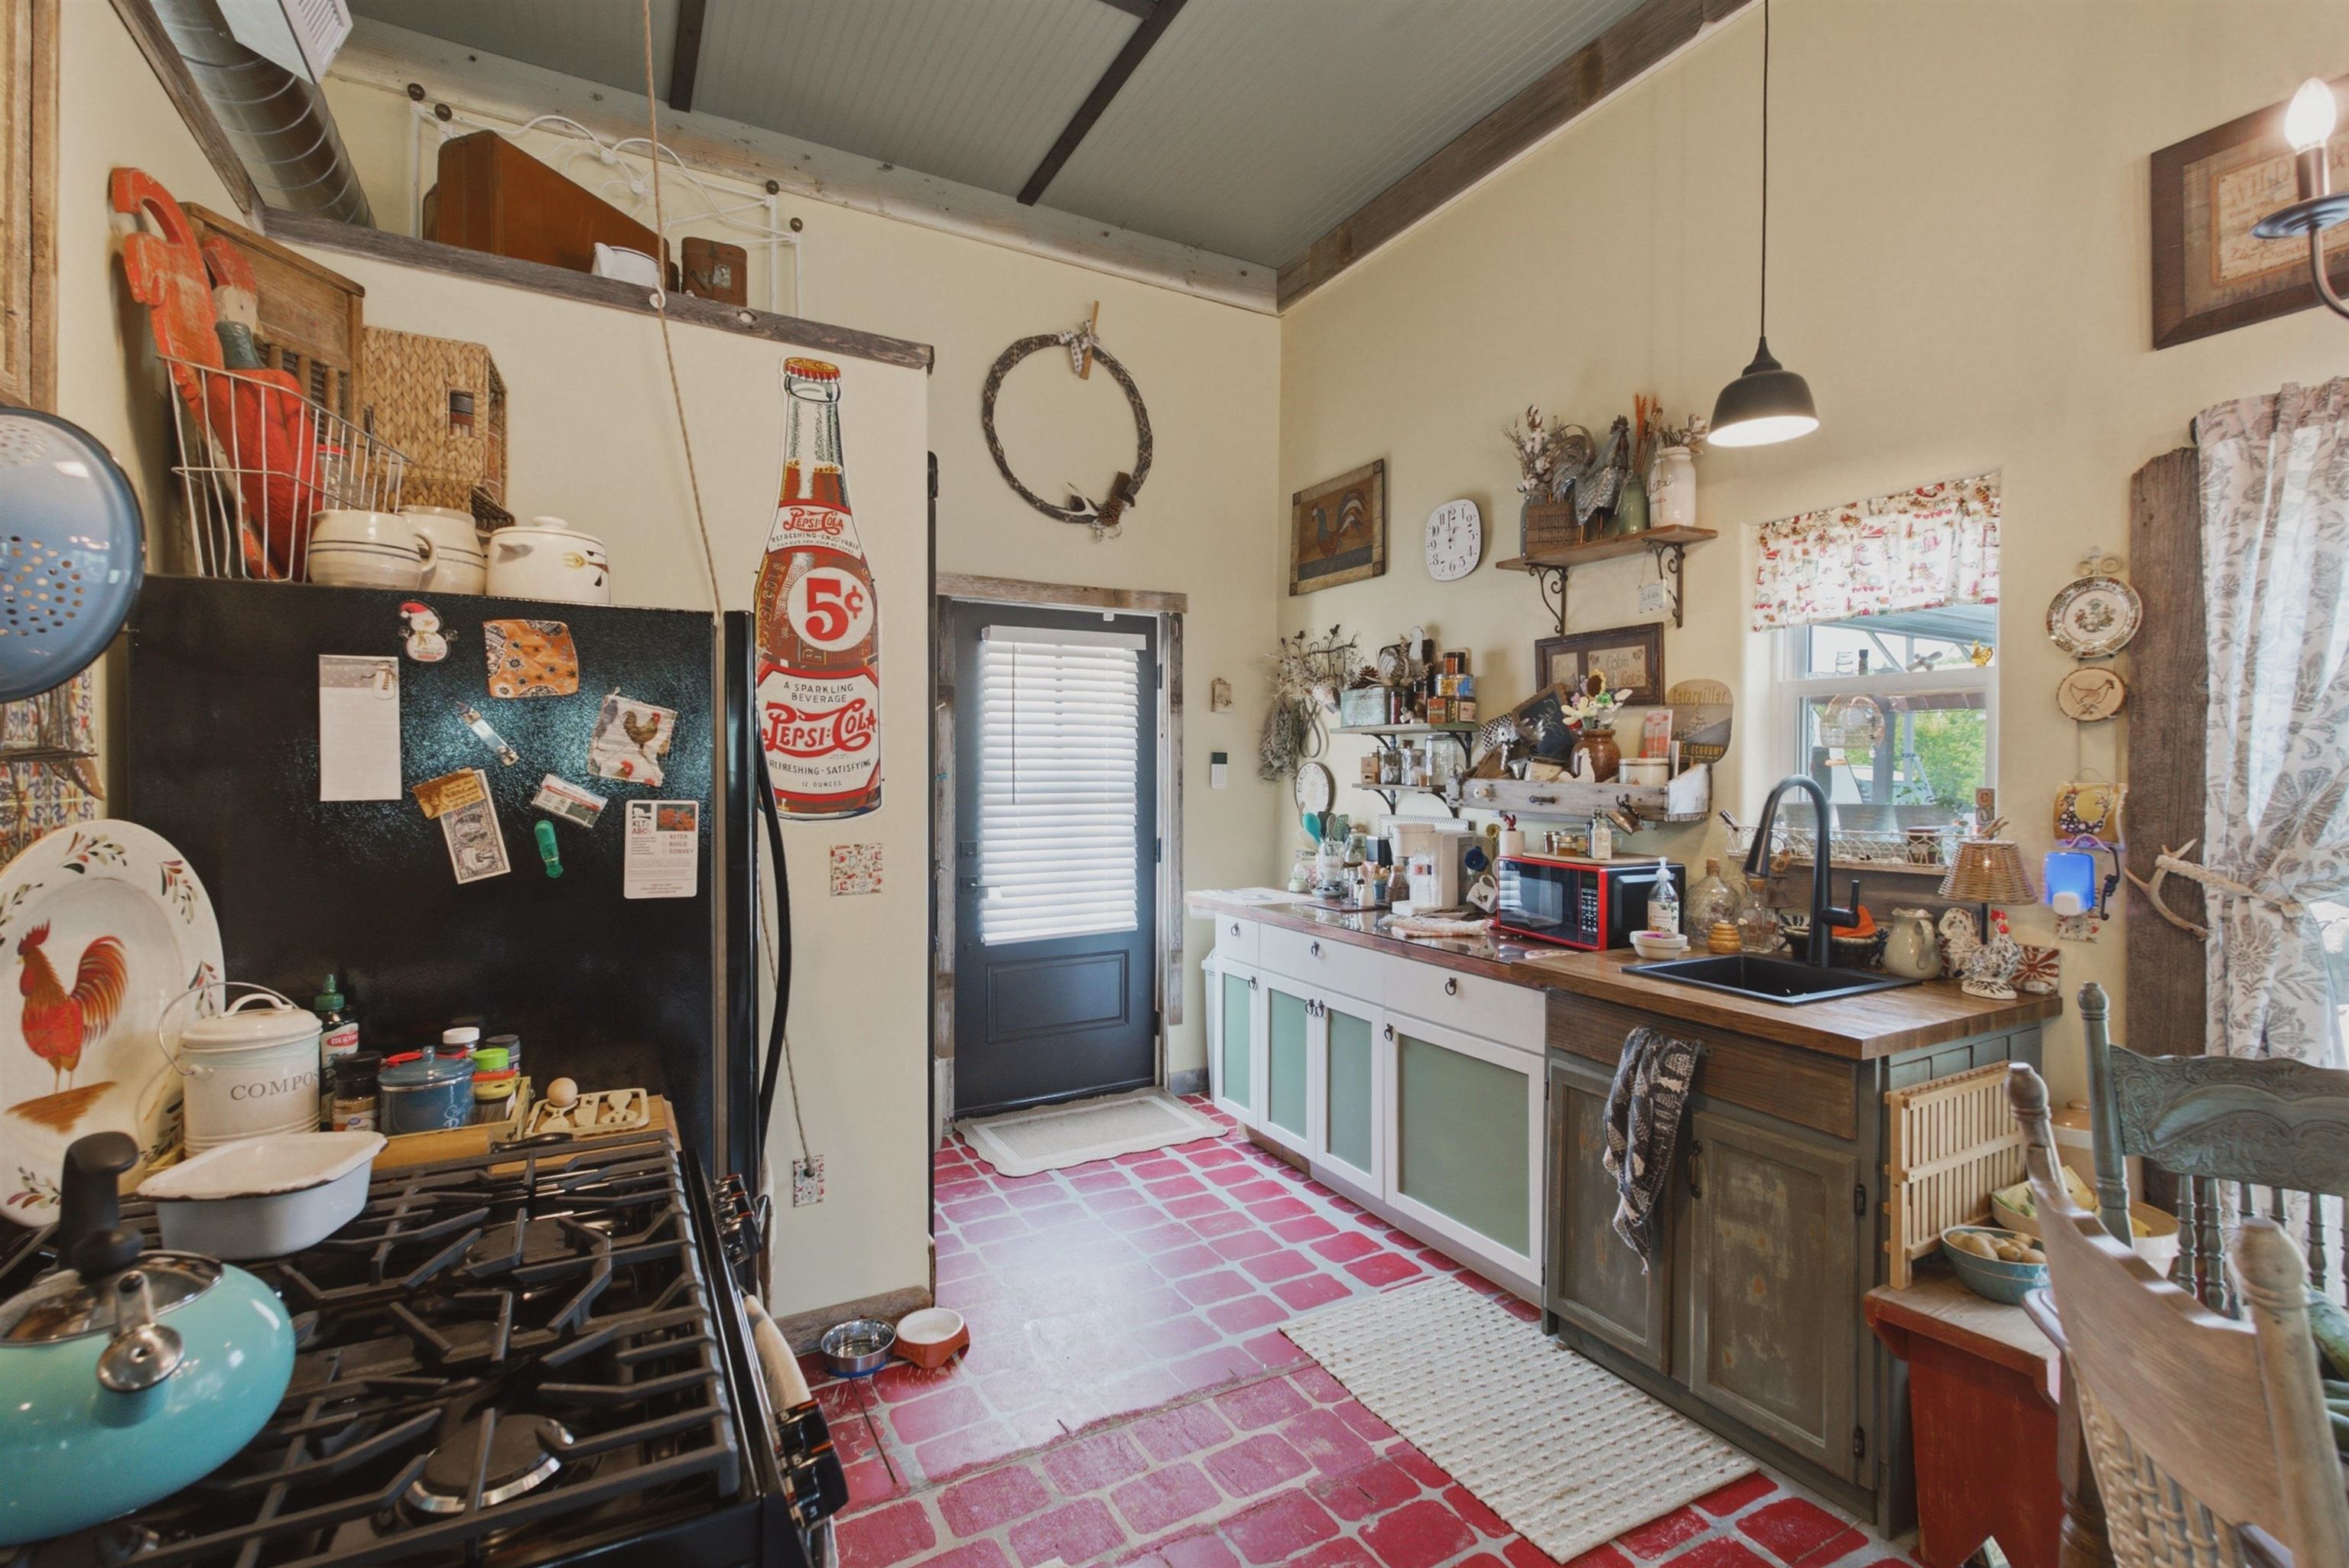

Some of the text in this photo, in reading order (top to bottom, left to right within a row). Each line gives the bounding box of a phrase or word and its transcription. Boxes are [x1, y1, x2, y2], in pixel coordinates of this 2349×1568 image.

[783, 681, 854, 694] A SPARKLING
[791, 693, 847, 703] BEVERAGE
[768, 758, 872, 776] REFRESHING SATISFYING
